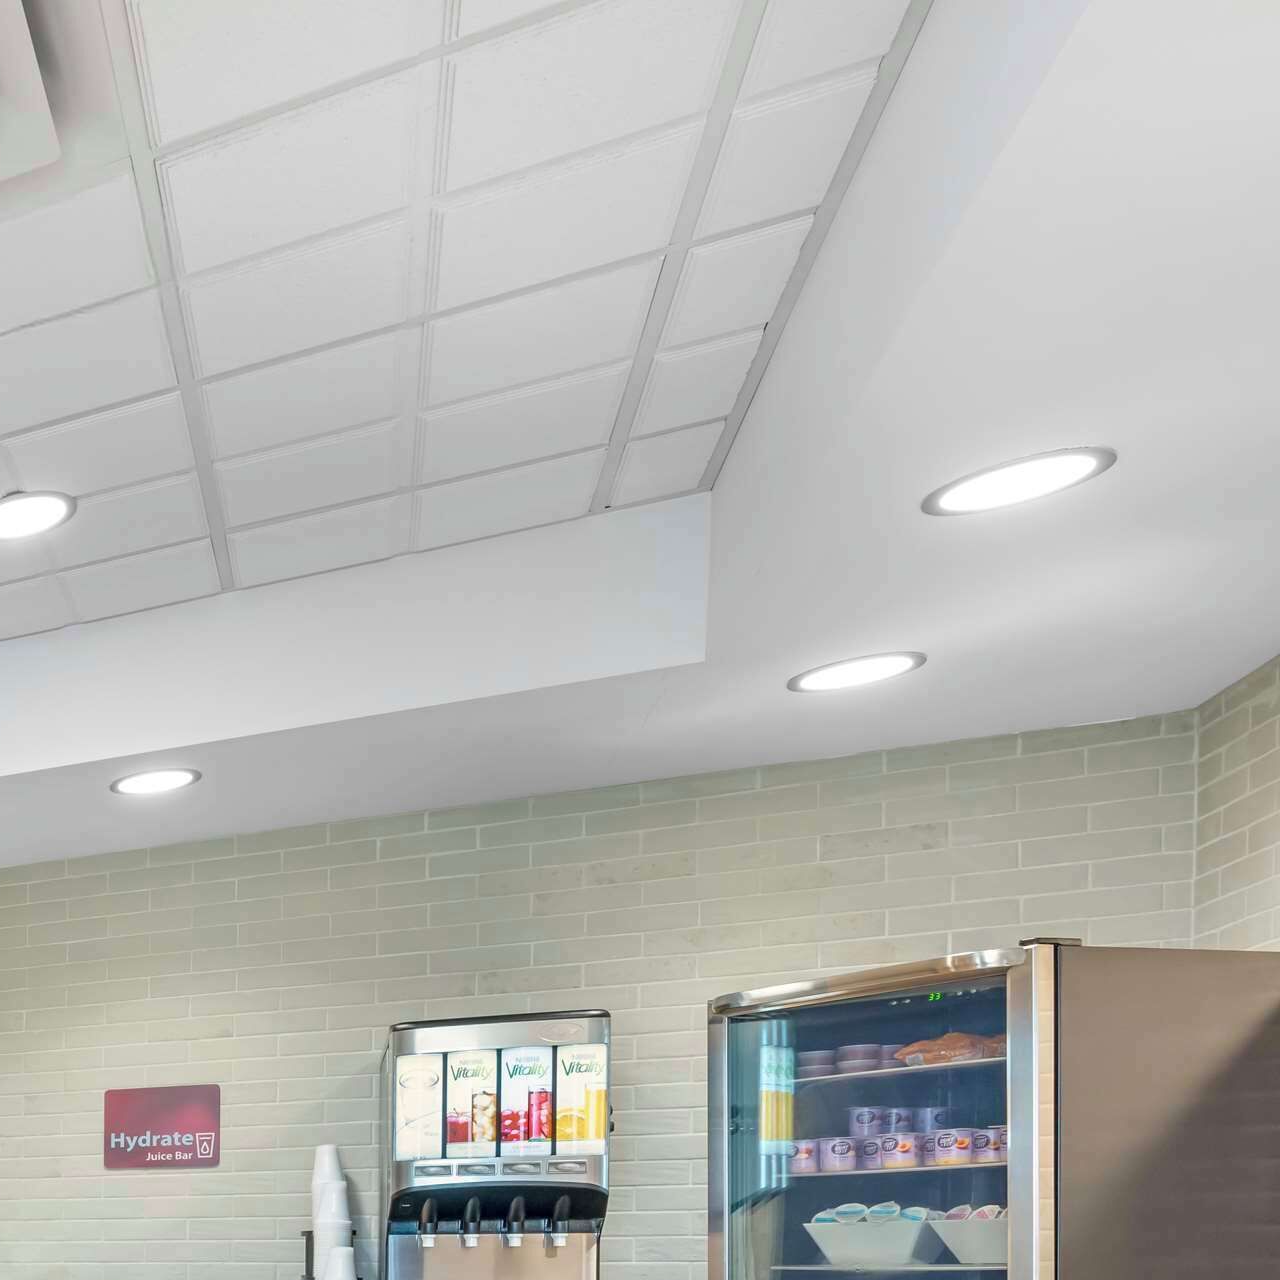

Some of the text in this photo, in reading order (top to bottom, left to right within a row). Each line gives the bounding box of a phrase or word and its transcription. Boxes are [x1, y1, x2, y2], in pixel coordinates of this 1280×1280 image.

[451, 1064, 494, 1081] Vitality
[506, 1061, 549, 1079] Vitality
[561, 1058, 605, 1077] Vitality
[110, 1131, 194, 1152] Hydrate
[146, 1151, 194, 1161] Juice Bar
